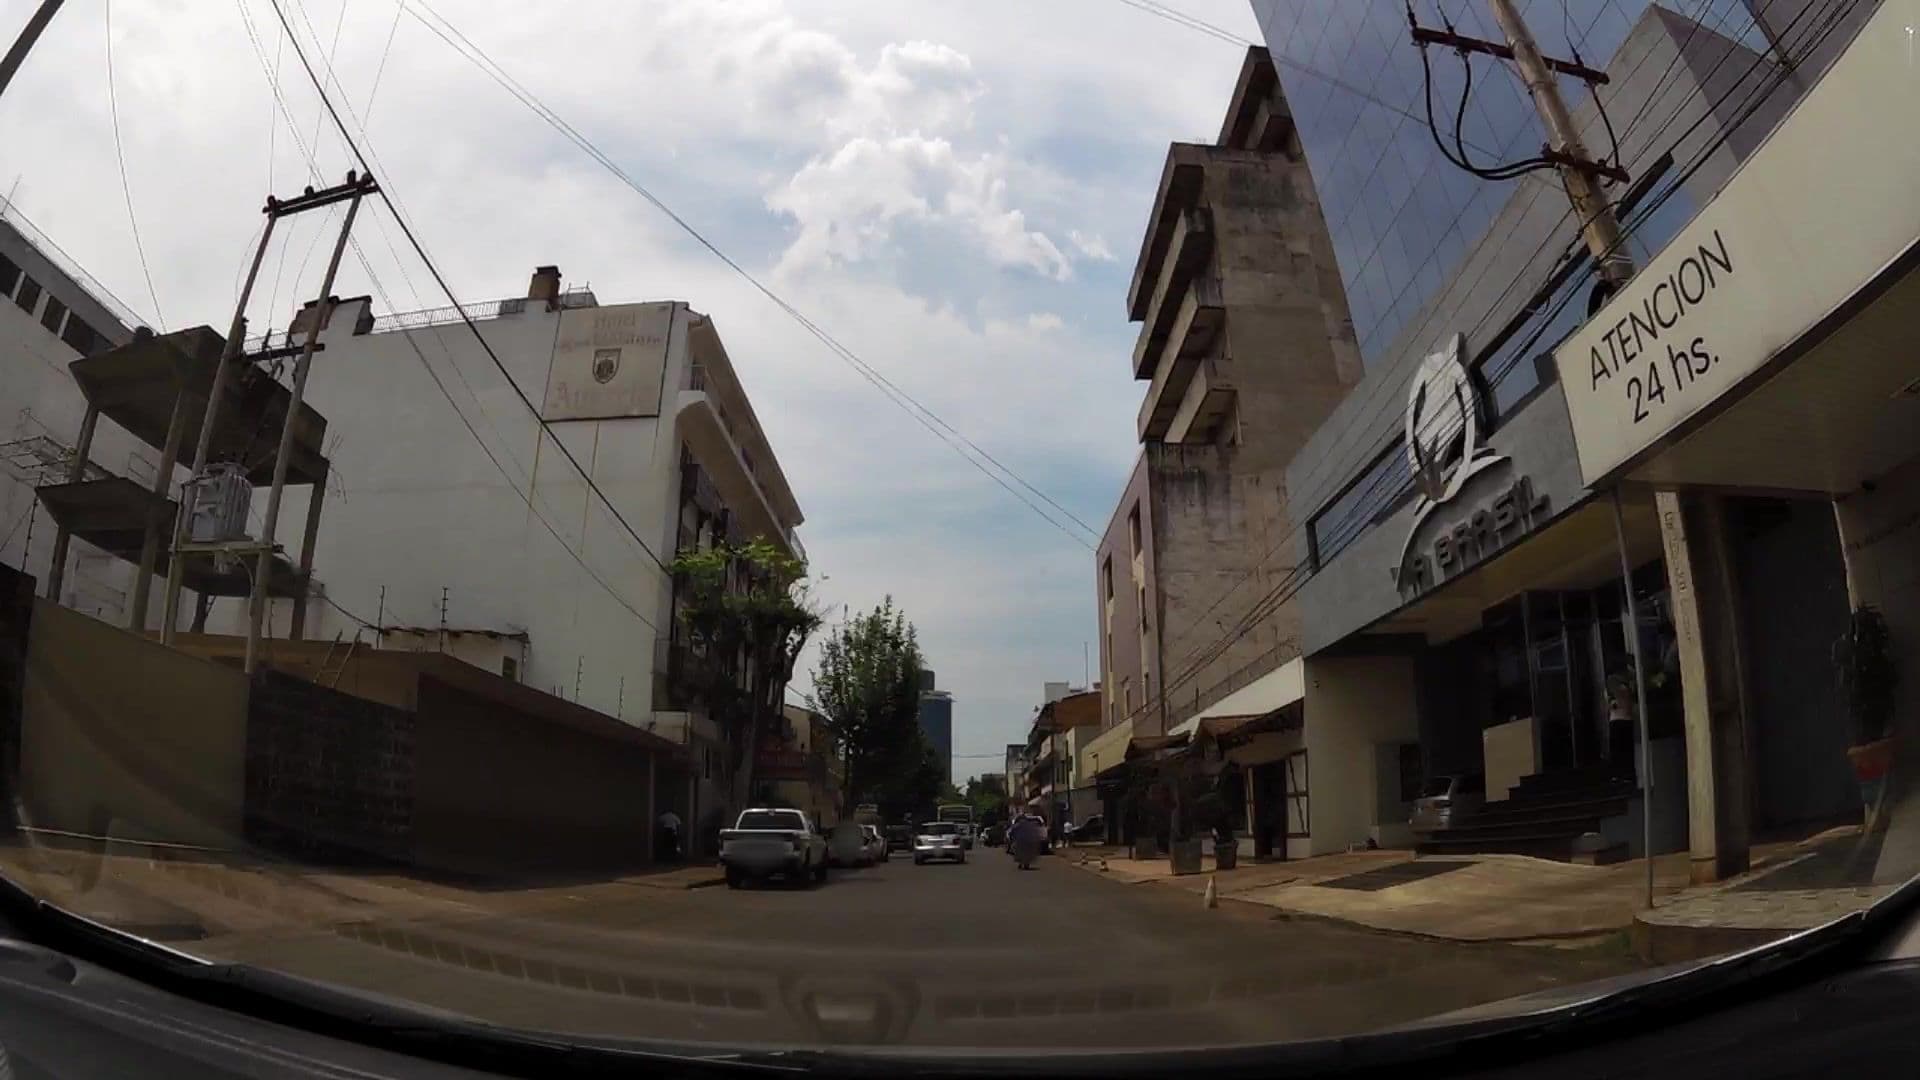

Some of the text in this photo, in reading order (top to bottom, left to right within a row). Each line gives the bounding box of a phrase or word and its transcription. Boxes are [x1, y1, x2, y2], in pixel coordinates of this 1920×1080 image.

[1591, 230, 1733, 392] ATENCION
[1627, 337, 1720, 424] 24 hs.
[1434, 475, 1553, 577] BRASIL
